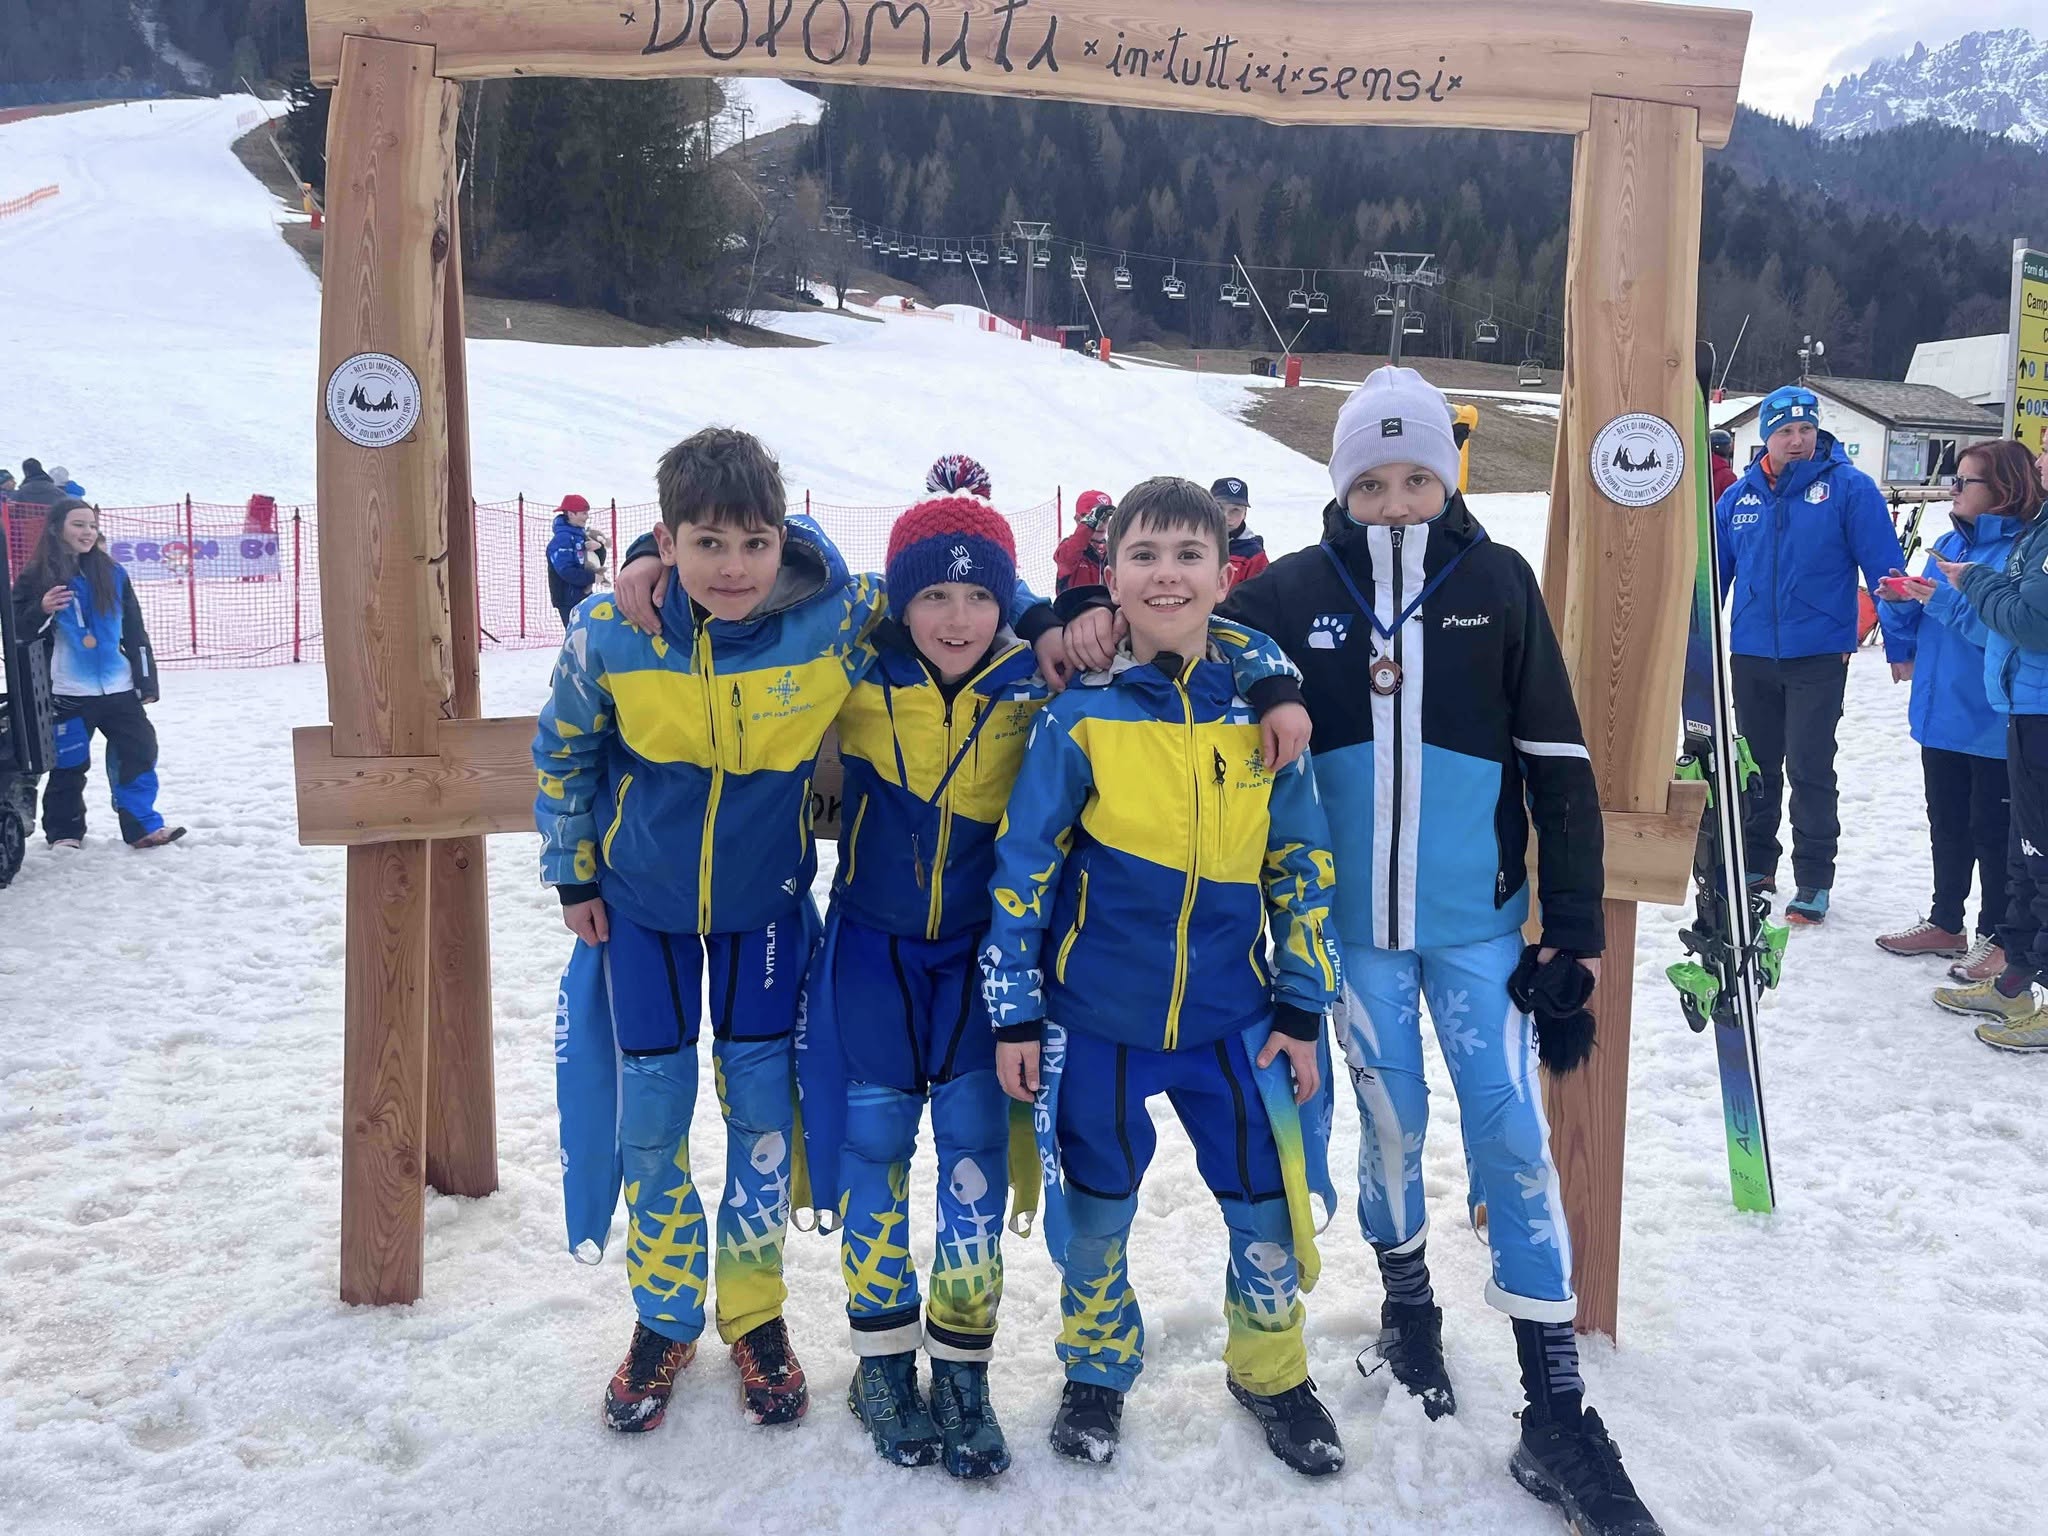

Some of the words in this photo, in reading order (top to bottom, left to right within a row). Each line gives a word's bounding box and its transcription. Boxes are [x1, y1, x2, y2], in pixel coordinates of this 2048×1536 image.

[1105, 31, 1148, 78] in
[1162, 27, 1253, 93] tutti
[1301, 55, 1447, 101] sensi
[353, 363, 367, 374] RETE
[376, 363, 401, 378] IMPRESE
[359, 428, 386, 439] DOLOMITI
[1616, 423, 1631, 434] RETE
[1638, 422, 1663, 436] IMPRESE
[1623, 488, 1650, 498] DOLOMITI
[1442, 613, 1490, 628] phenix
[1688, 721, 1708, 731] MATEO
